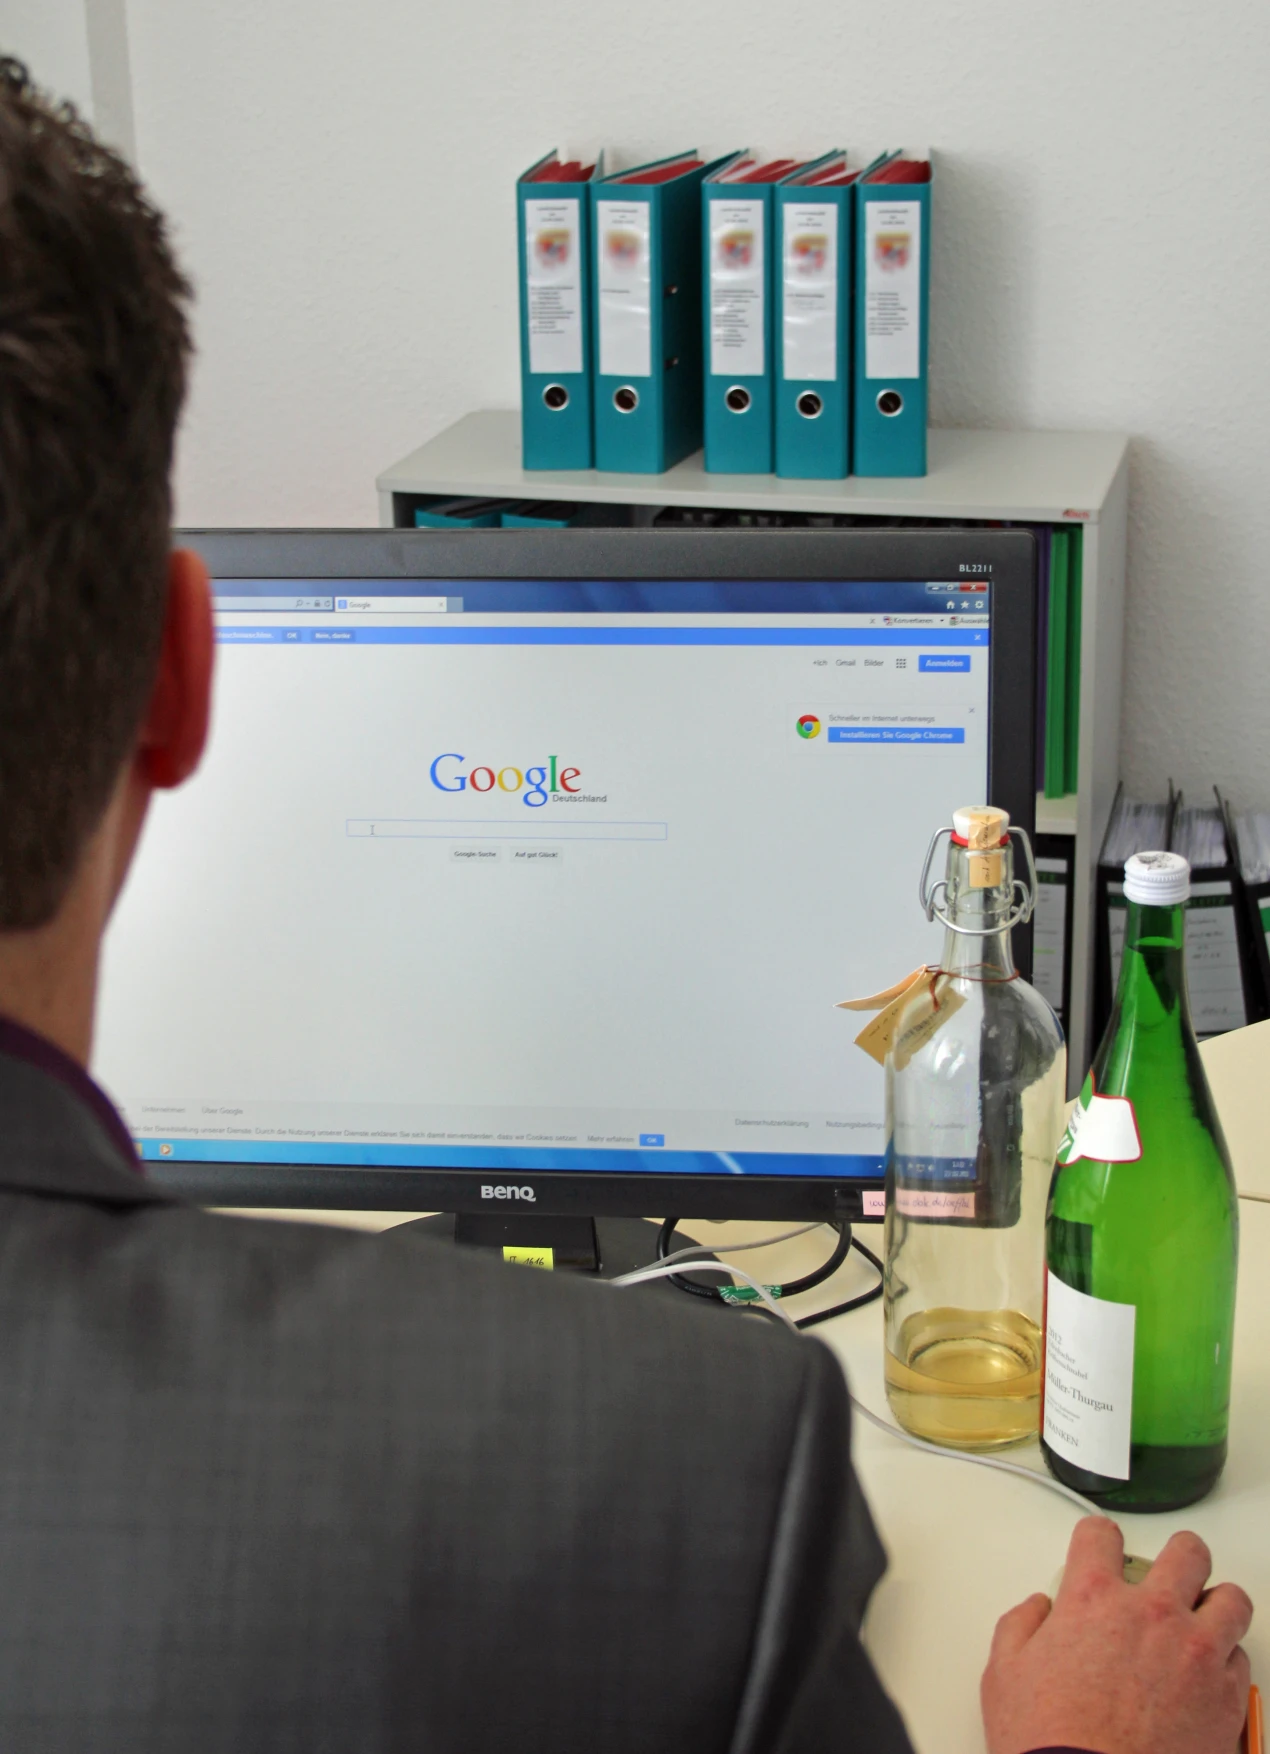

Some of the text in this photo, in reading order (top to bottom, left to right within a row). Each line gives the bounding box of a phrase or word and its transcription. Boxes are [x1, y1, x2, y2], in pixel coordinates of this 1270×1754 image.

[958, 564, 993, 573] BL2211
[835, 658, 856, 667] Gmail
[864, 658, 884, 667] Bilder
[925, 659, 964, 668] Anmelden
[872, 714, 899, 723] Internet
[839, 731, 953, 742] Installieren Sie Google Chrome
[429, 753, 582, 808] Google
[551, 793, 608, 803] Deutschland
[734, 1117, 810, 1130] Datenschutzerklärung
[1046, 1367, 1114, 1412] Müller-Thurgau
[1045, 1415, 1079, 1447] FRANKEN
